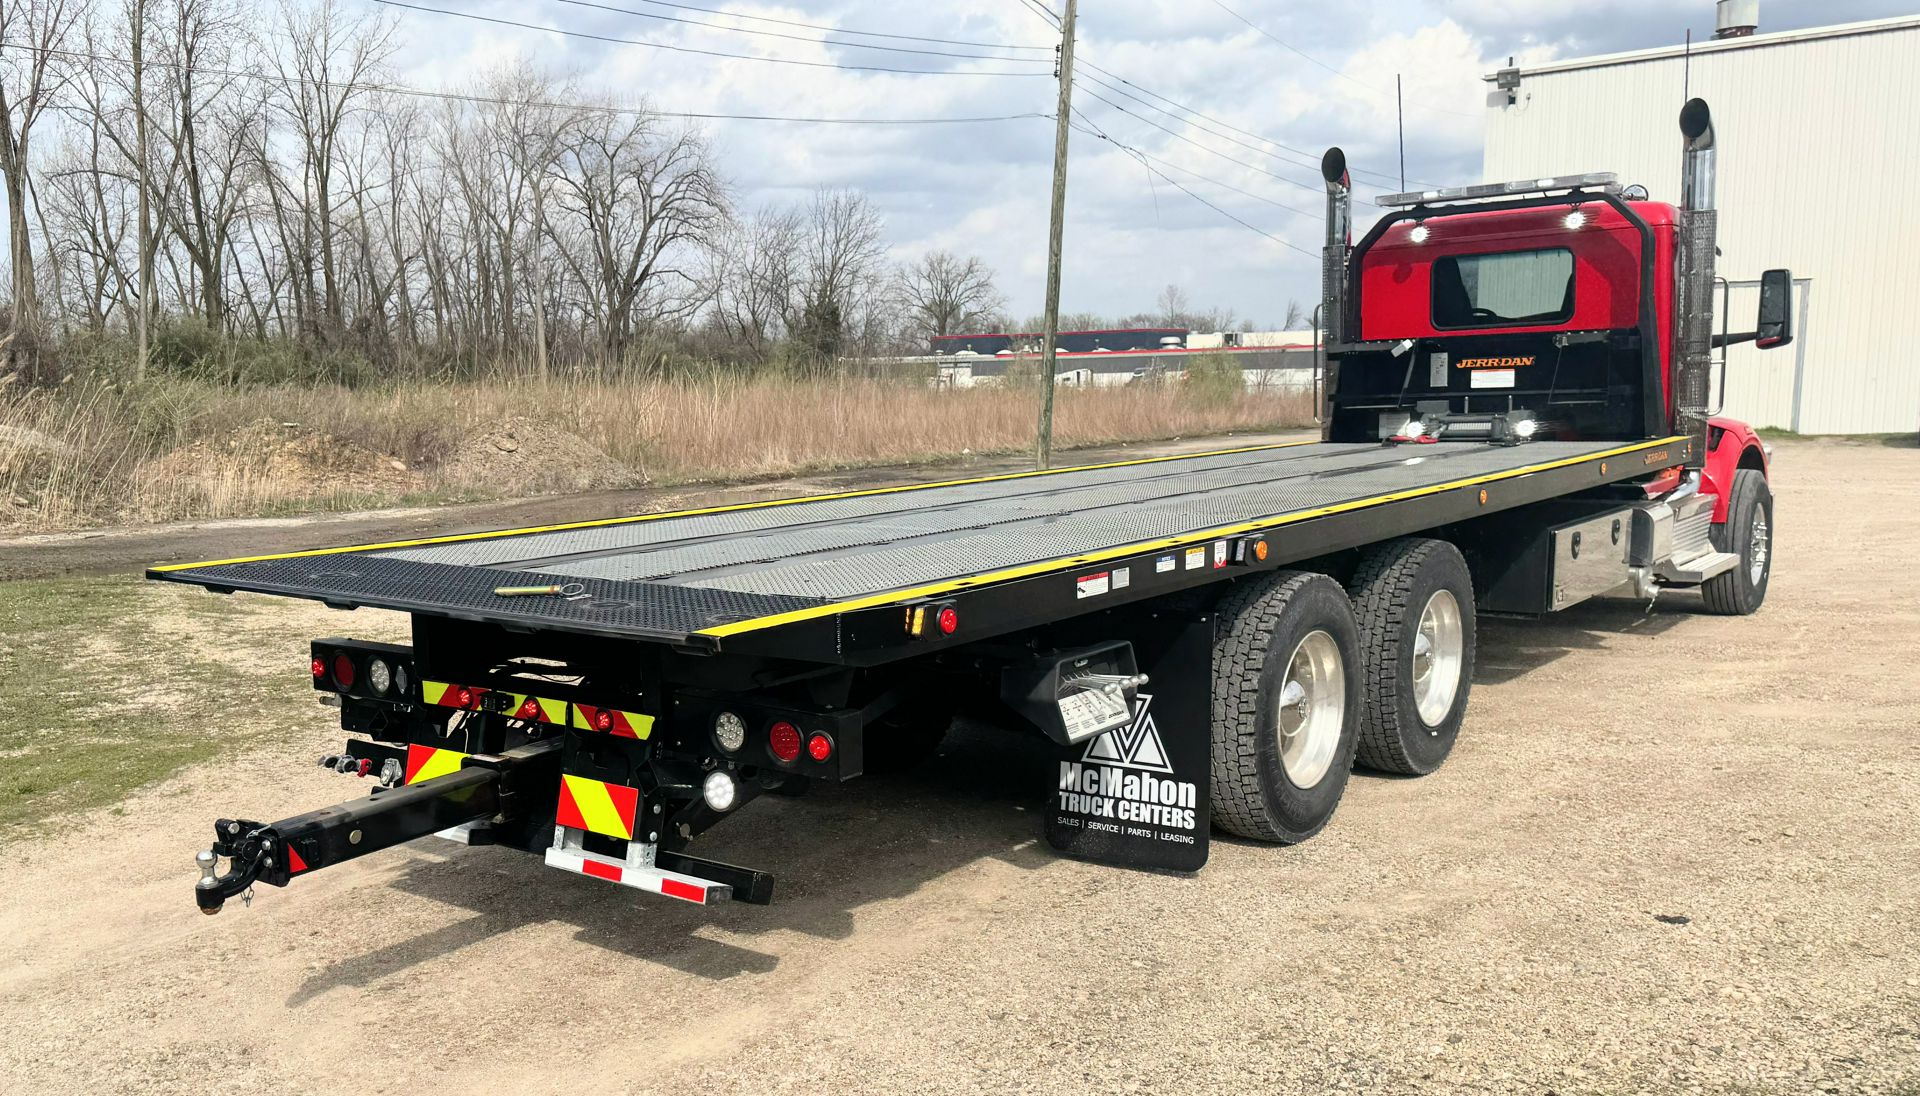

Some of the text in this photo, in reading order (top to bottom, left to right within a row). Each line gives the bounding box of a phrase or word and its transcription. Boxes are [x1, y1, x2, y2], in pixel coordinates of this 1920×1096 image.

[1059, 761, 1196, 808] McMahon
[1059, 791, 1196, 830] TRUCK CENTERS
[1057, 816, 1195, 845] SALES SERVICE PARTS LEASING
